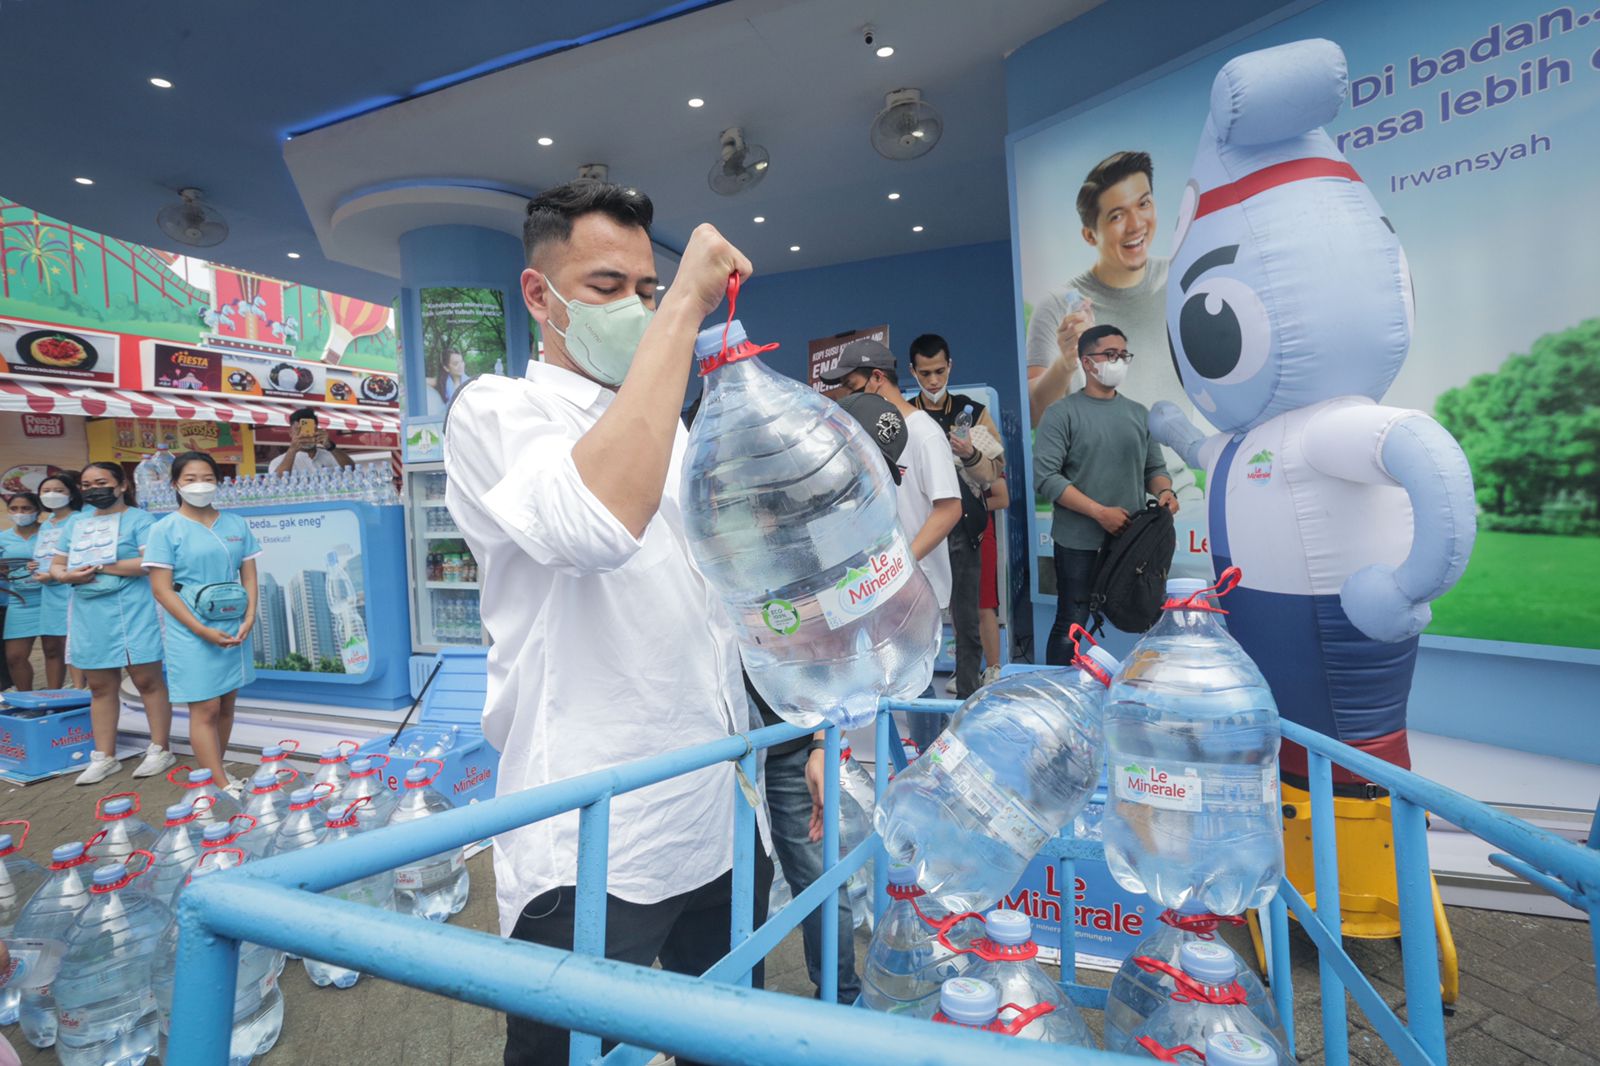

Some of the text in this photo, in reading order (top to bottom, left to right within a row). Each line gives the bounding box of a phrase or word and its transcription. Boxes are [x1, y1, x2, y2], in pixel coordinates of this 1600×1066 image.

[1351, 64, 1395, 109] Di
[1336, 109, 1424, 154] rasa
[1440, 56, 1571, 123] lebih
[1390, 133, 1552, 193] Irwansyah
[177, 354, 208, 367] FIESTA
[812, 345, 839, 362] KOPI SUSU
[24, 415, 60, 425] Ready
[27, 425, 60, 434] Meal
[279, 518, 296, 529] gak
[871, 552, 889, 573] Le
[848, 556, 904, 605] Minerale
[453, 769, 491, 794] Minerale
[466, 767, 477, 778] Le
[1151, 768, 1168, 783] Le
[1127, 776, 1186, 798] Minerale
[1046, 865, 1086, 900] Le
